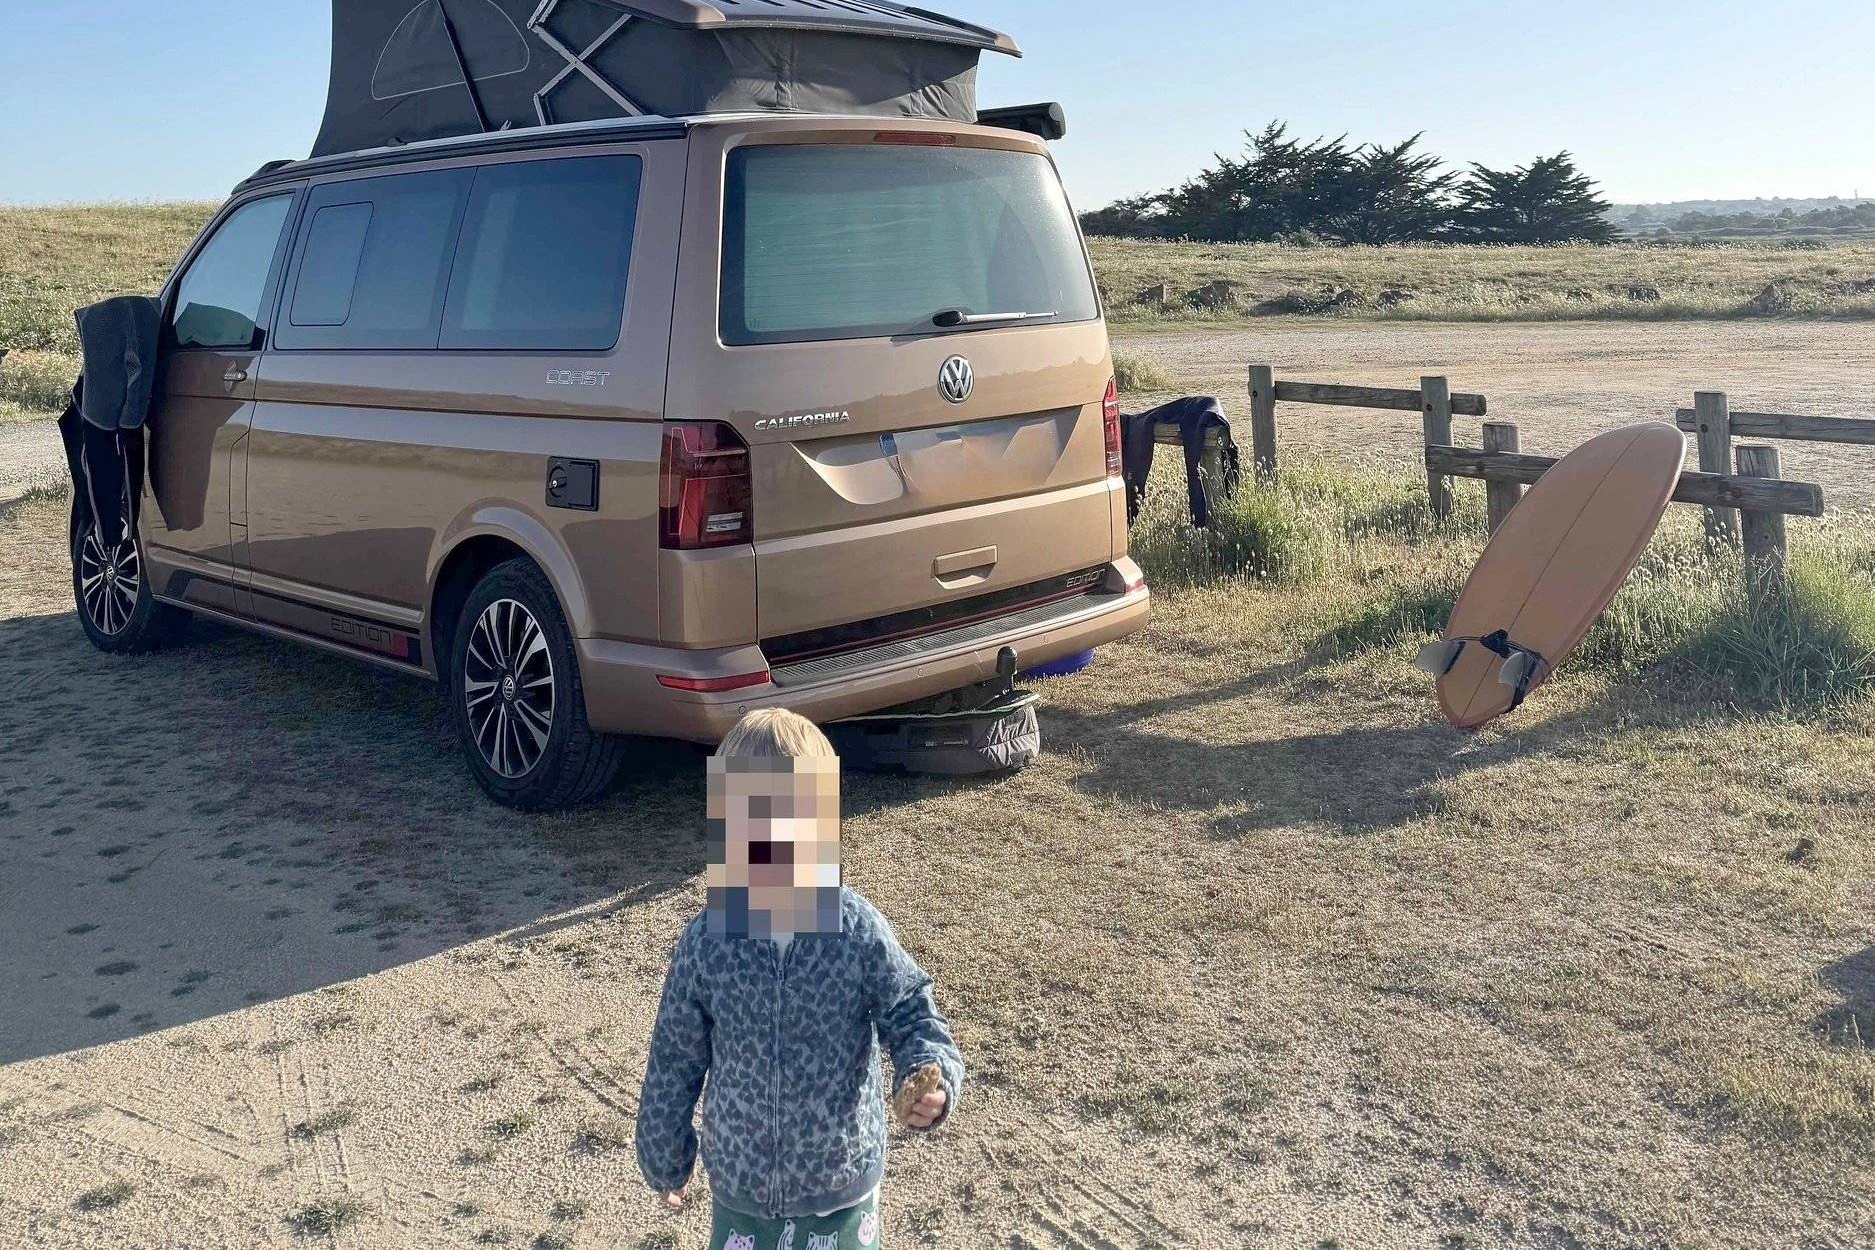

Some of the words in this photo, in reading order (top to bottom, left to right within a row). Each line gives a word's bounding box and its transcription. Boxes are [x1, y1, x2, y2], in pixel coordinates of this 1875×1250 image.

[546, 369, 611, 386] COAST
[939, 354, 975, 403] VW
[754, 411, 850, 431] CALIFORNIA
